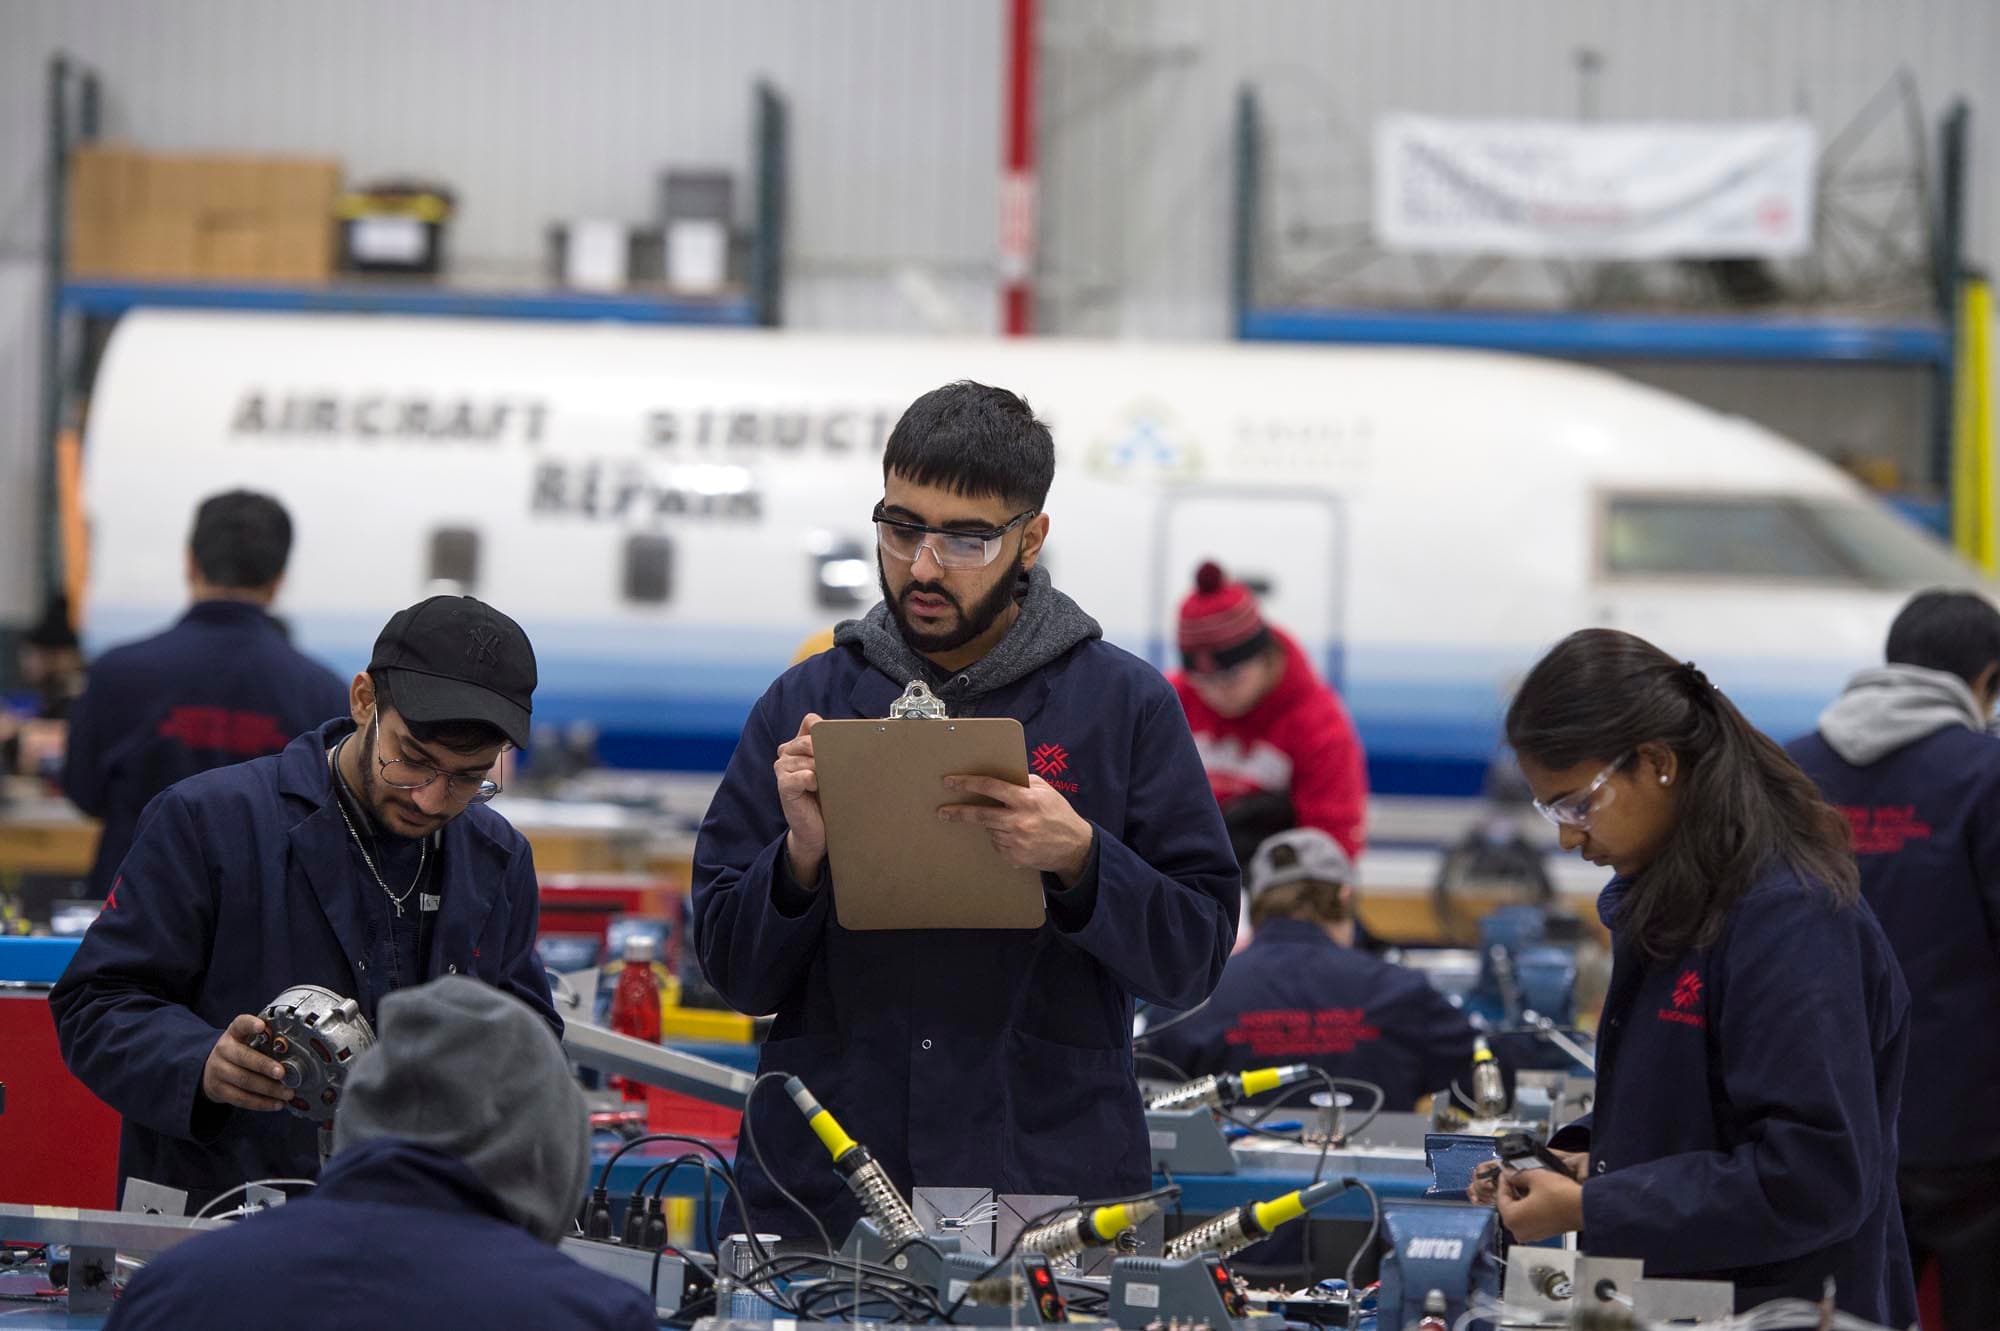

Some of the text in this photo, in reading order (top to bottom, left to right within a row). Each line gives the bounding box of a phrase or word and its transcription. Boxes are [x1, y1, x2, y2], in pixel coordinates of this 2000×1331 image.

[232, 392, 888, 453] AIRCRAFT STRUCT
[1406, 1237, 1463, 1259] aurora
